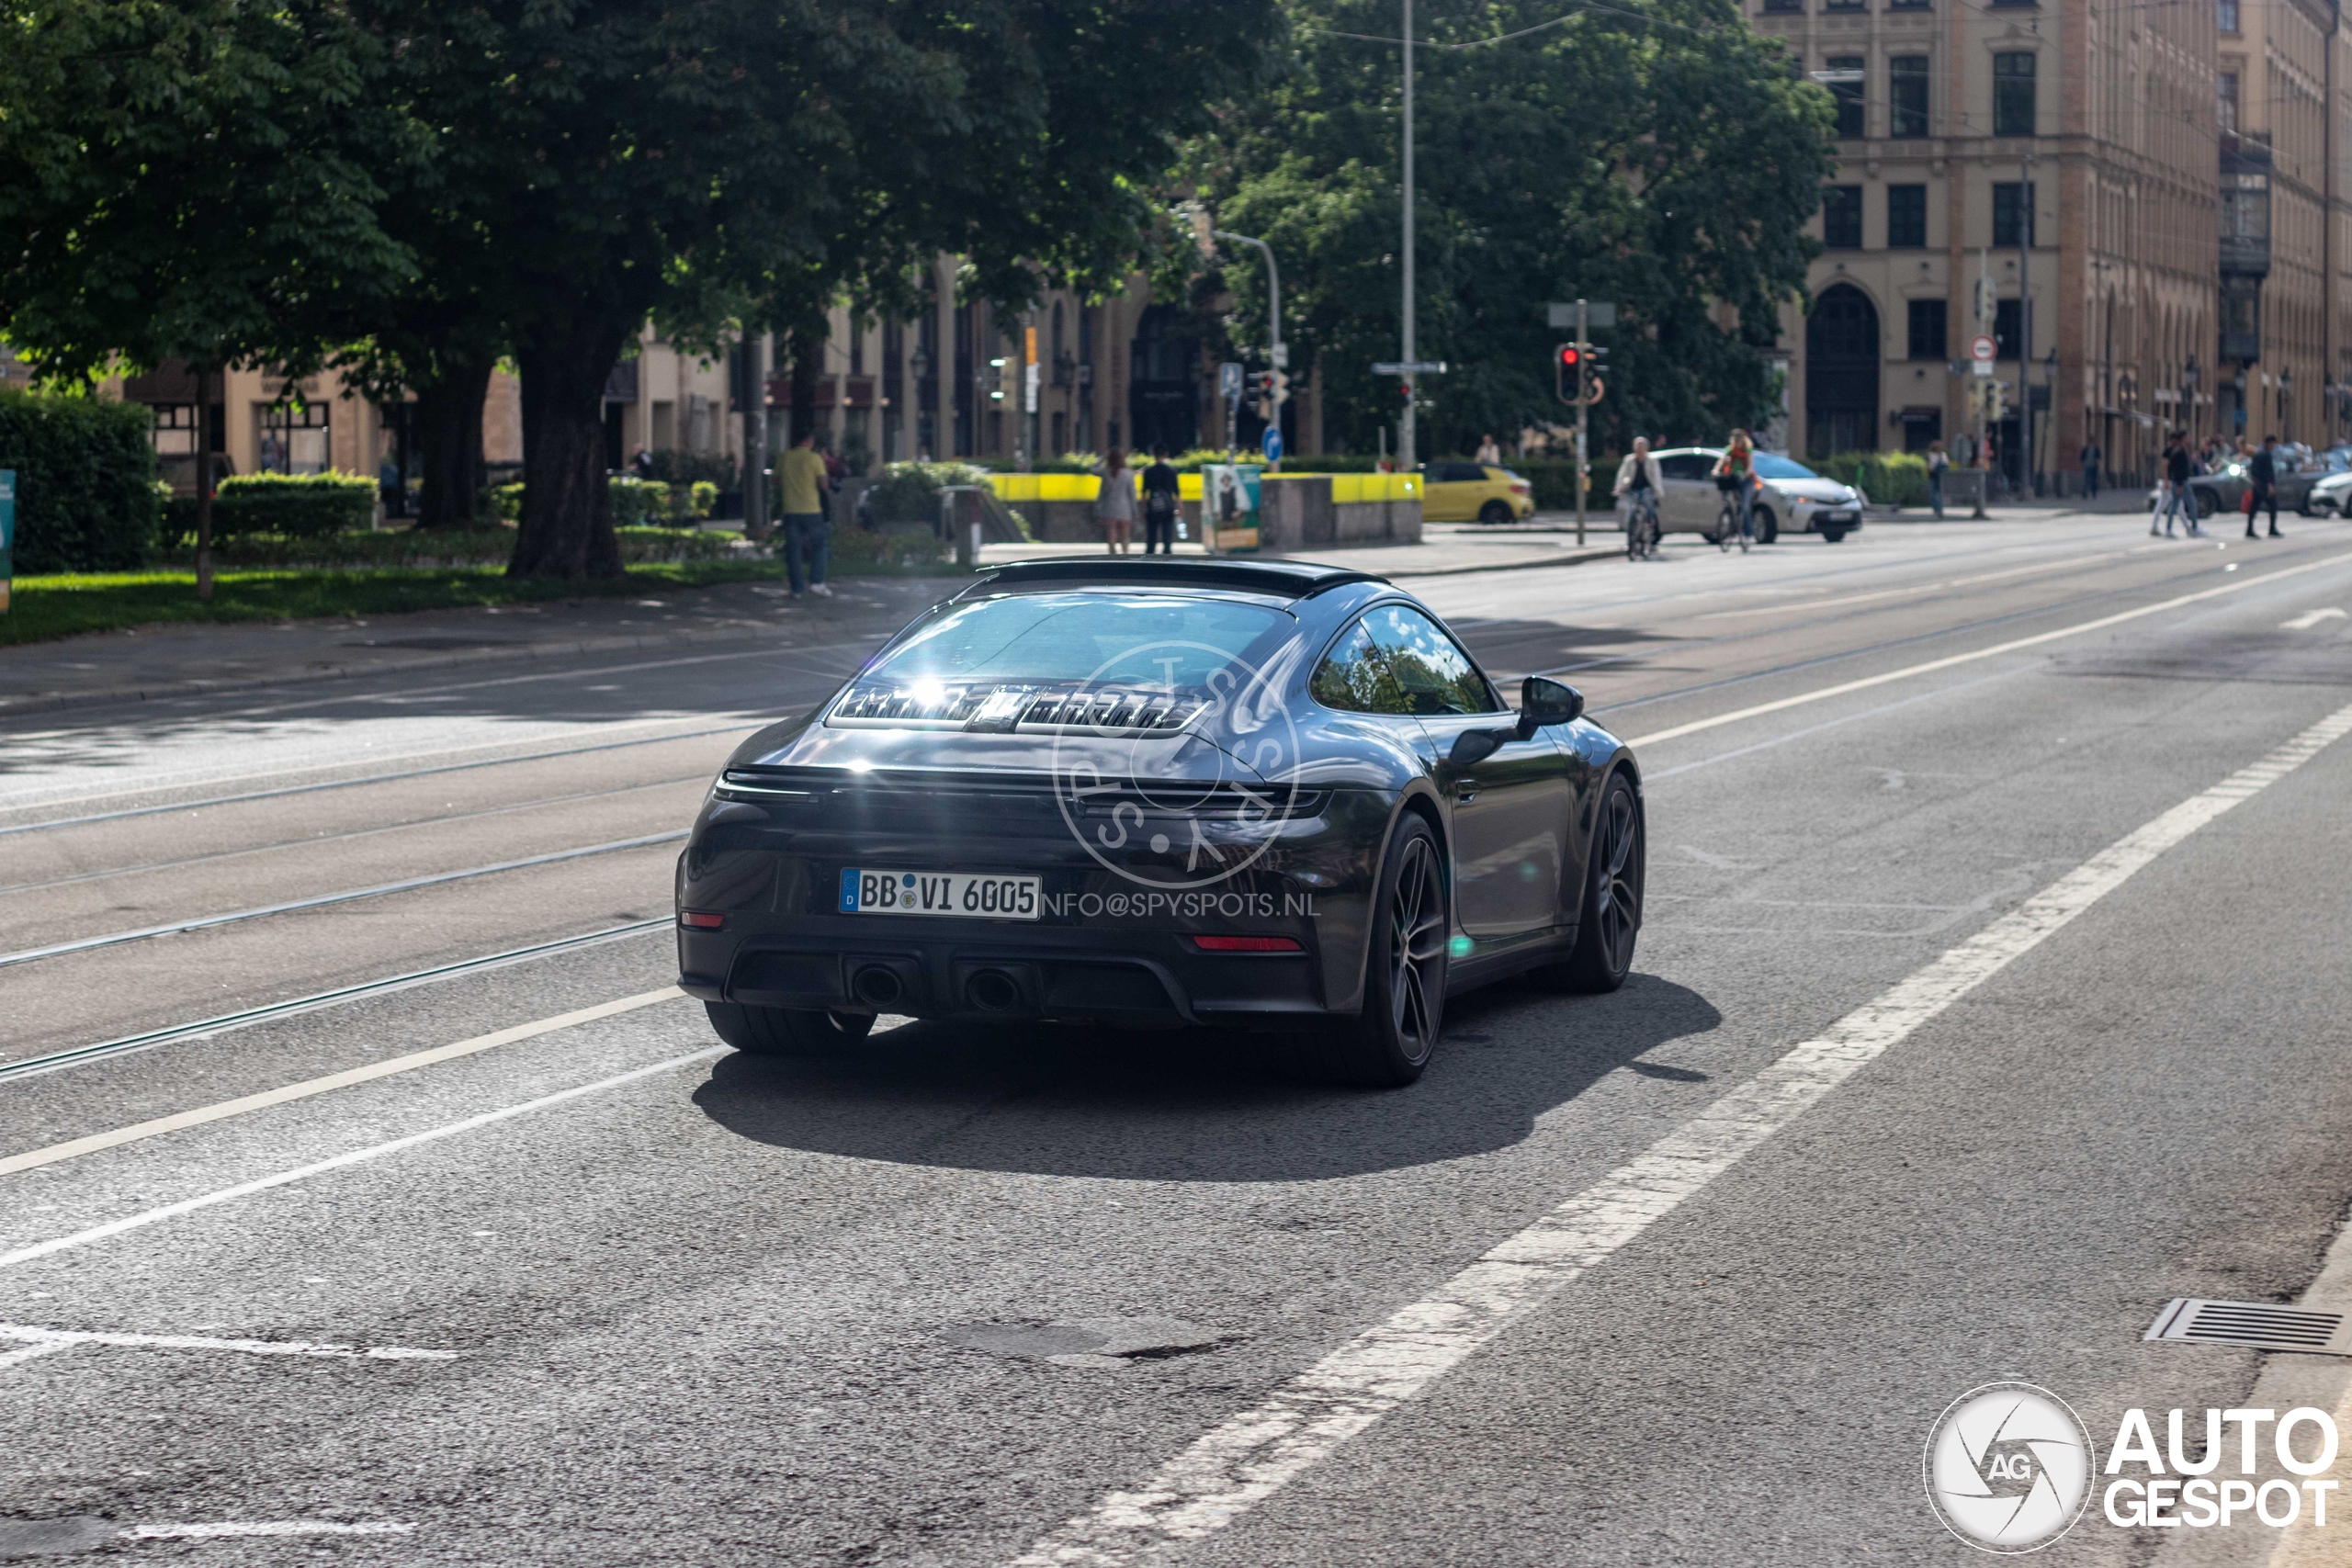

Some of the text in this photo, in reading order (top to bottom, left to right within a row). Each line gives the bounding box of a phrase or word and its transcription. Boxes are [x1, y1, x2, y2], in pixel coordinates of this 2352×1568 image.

[846, 874, 1035, 913] D BB VI 6005
